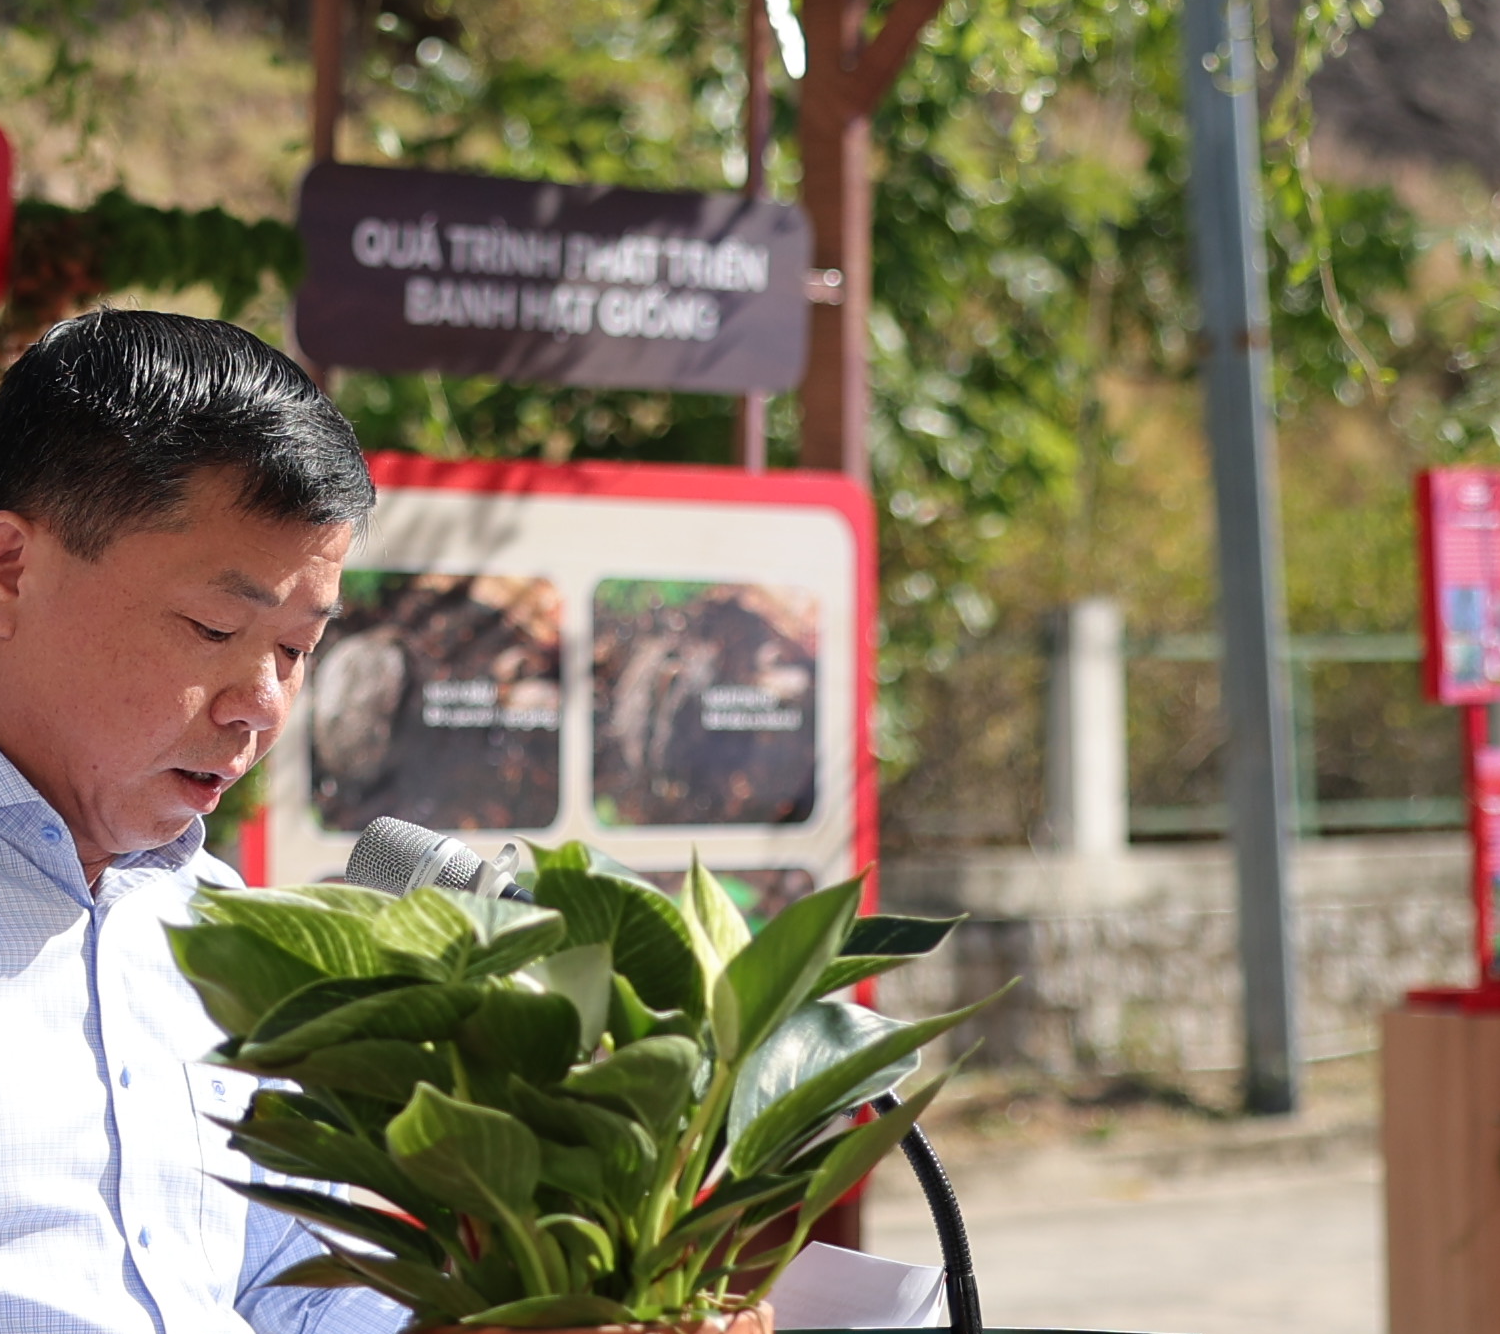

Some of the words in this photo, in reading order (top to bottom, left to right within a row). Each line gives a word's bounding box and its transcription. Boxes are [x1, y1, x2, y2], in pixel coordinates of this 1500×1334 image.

[353, 212, 442, 269] QUÁ
[404, 279, 517, 330] BANH
[518, 285, 595, 343] HẠT
